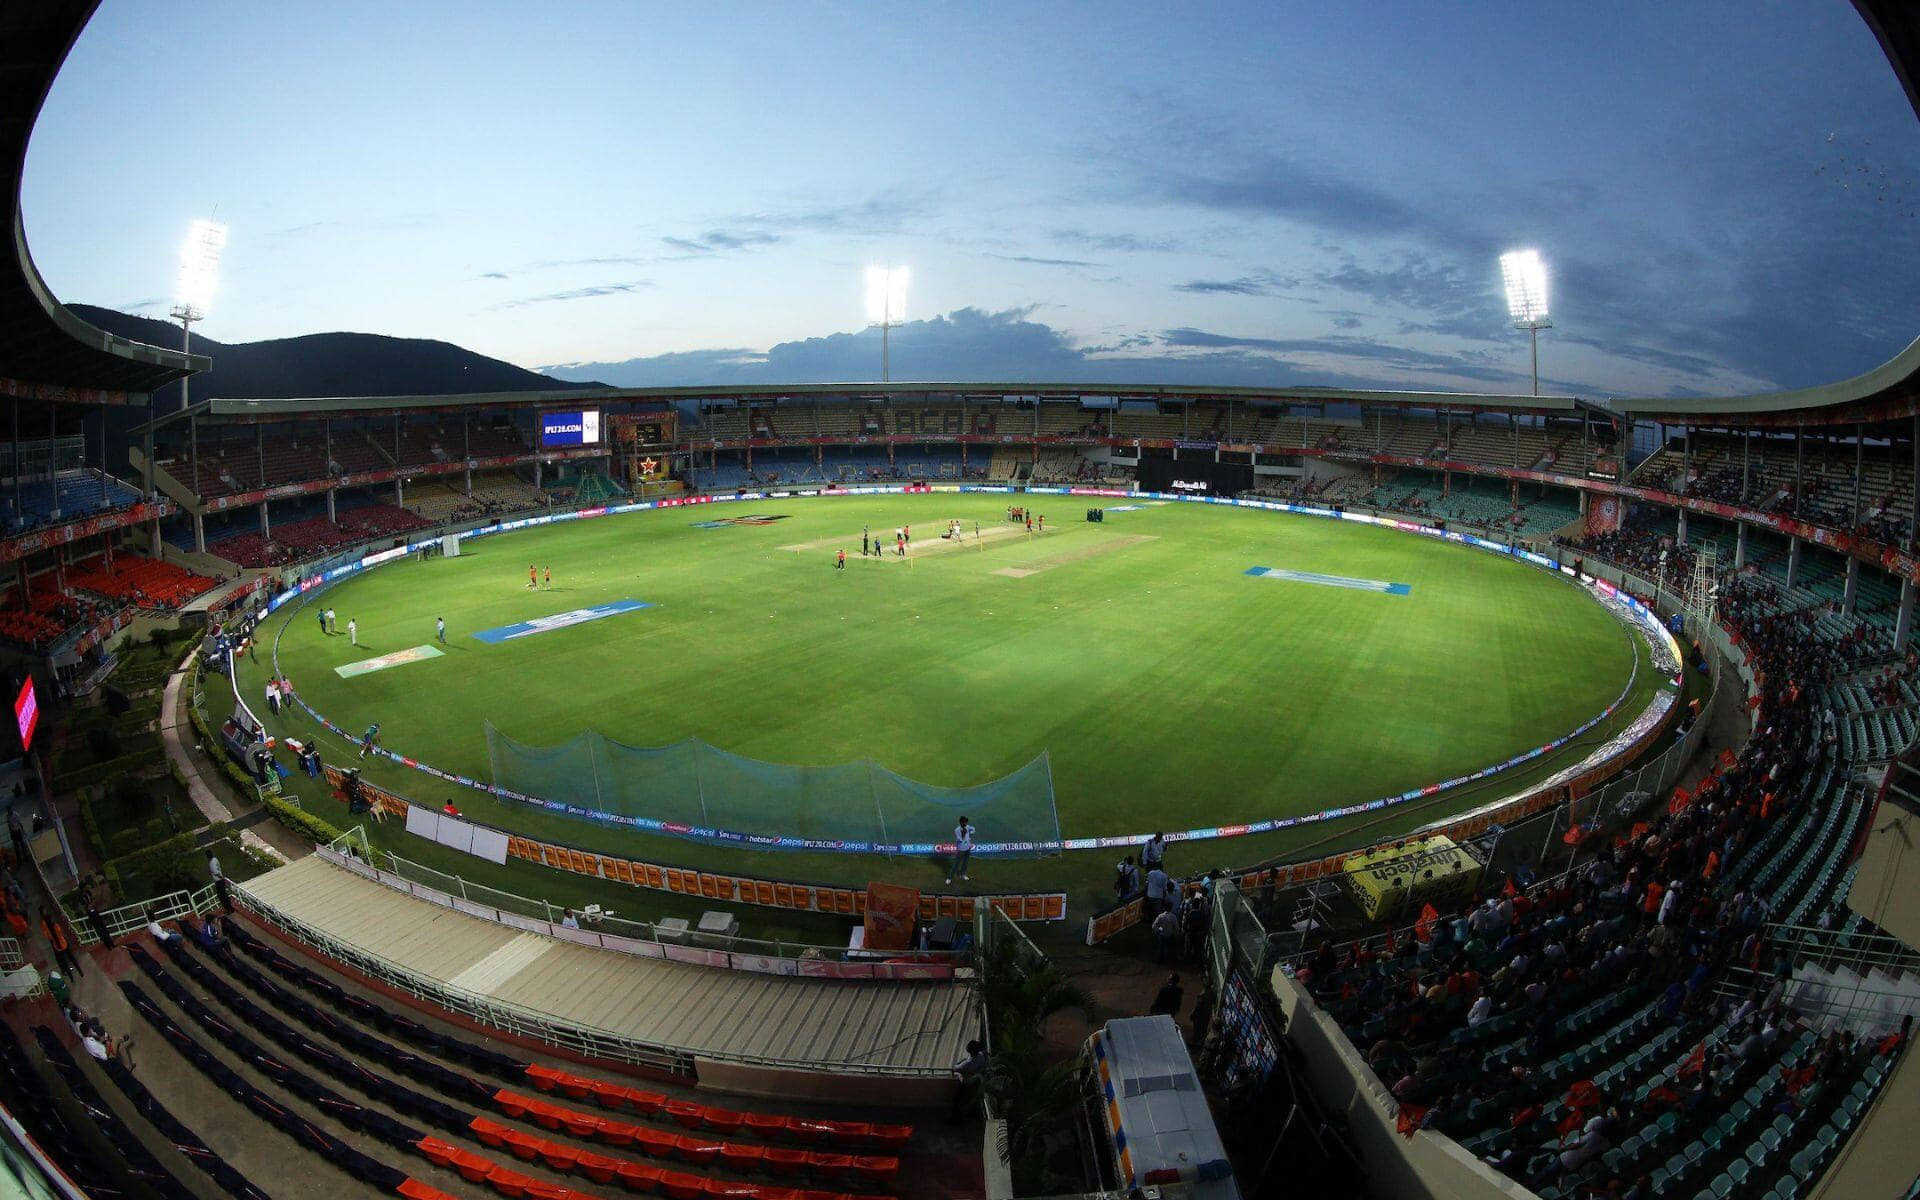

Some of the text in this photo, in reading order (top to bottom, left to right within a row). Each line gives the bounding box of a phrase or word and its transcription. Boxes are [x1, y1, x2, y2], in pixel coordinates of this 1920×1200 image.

[1252, 821, 1272, 831] pepsi
[694, 829, 714, 837] pepsi
[749, 835, 773, 844] hotstar
[782, 838, 804, 847] pepsi
[1073, 838, 1097, 849] pepsi
[844, 841, 868, 851] pepsi
[976, 843, 999, 852] pepsi
